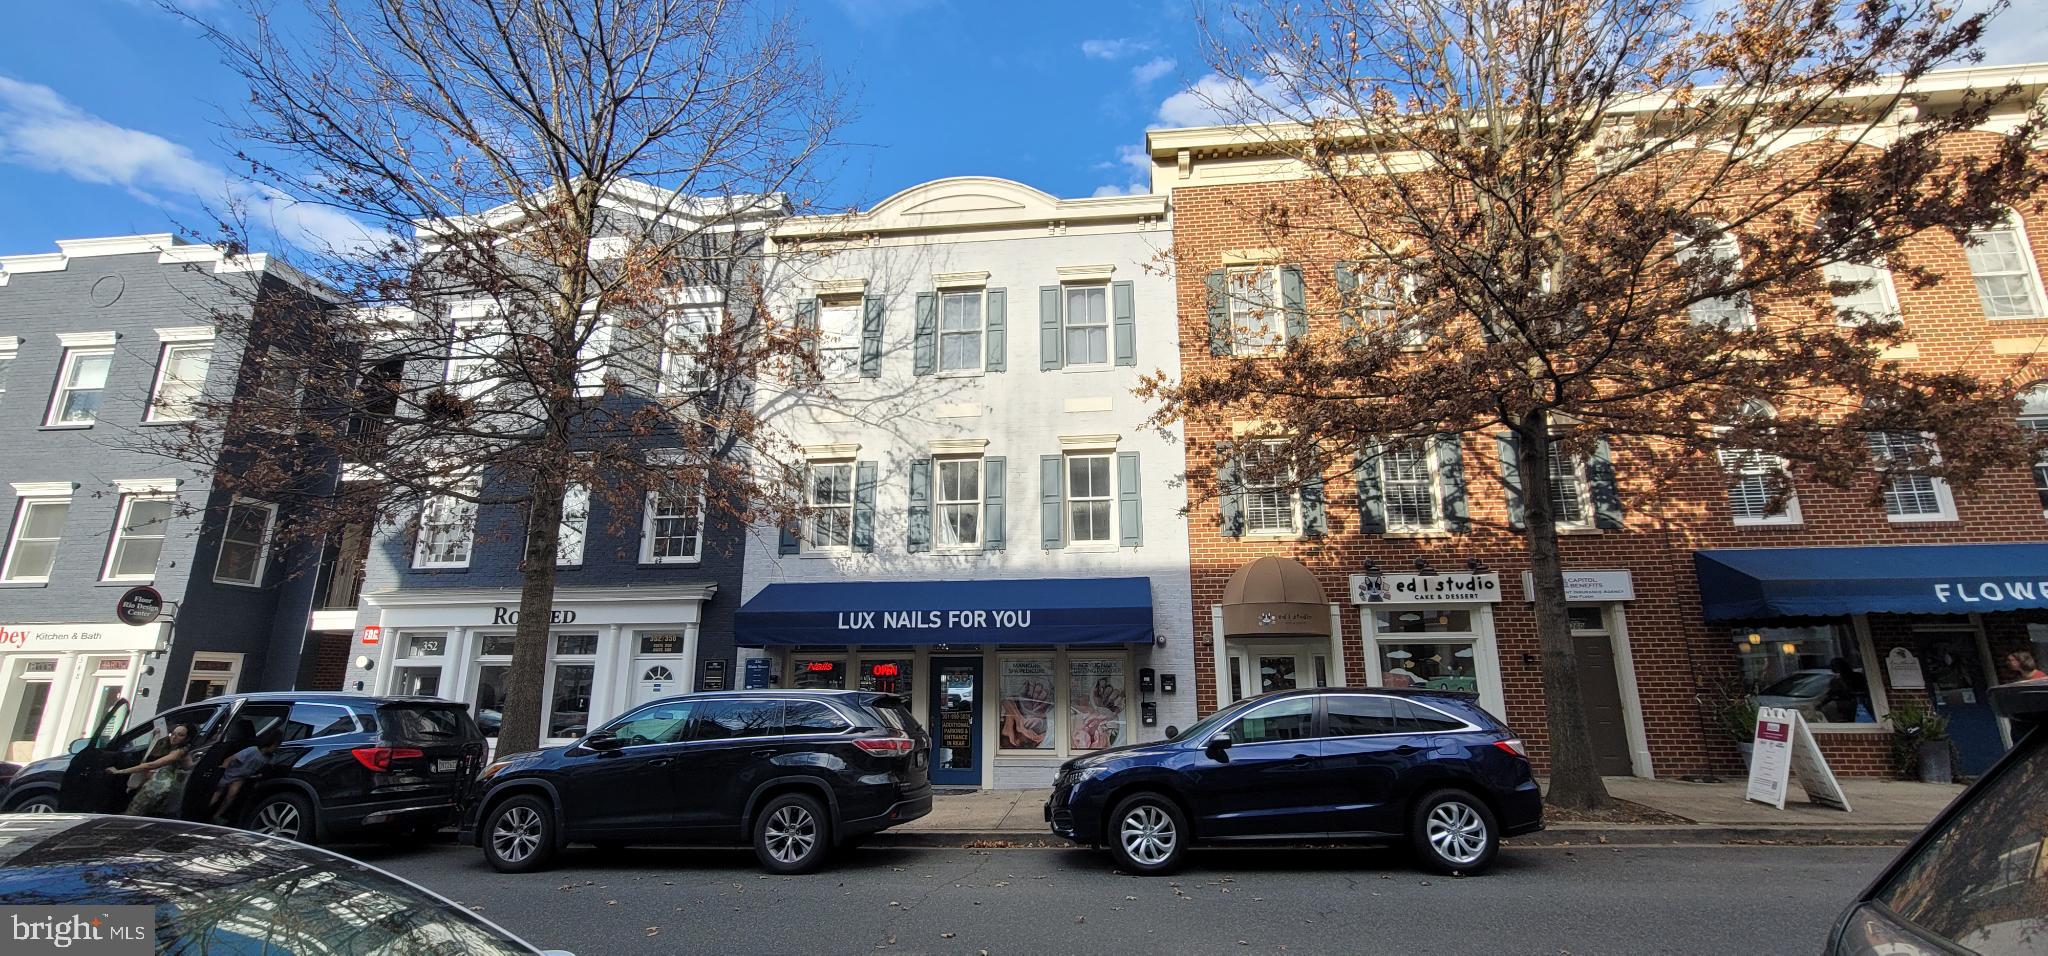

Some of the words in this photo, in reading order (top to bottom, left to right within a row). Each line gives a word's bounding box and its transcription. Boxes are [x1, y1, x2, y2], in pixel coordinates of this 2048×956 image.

[1396, 578, 1416, 592] ed
[1435, 576, 1494, 591] studio
[838, 612, 875, 629] LUX
[884, 611, 942, 628] NAILS
[949, 610, 987, 628] FOR
[992, 610, 1031, 628] YOU
[36, 632, 69, 640] Kitchen
[72, 632, 78, 640] &
[81, 632, 102, 640] Bath
[422, 641, 438, 650] 352
[806, 662, 832, 671] Nails
[873, 664, 898, 676] OPEN
